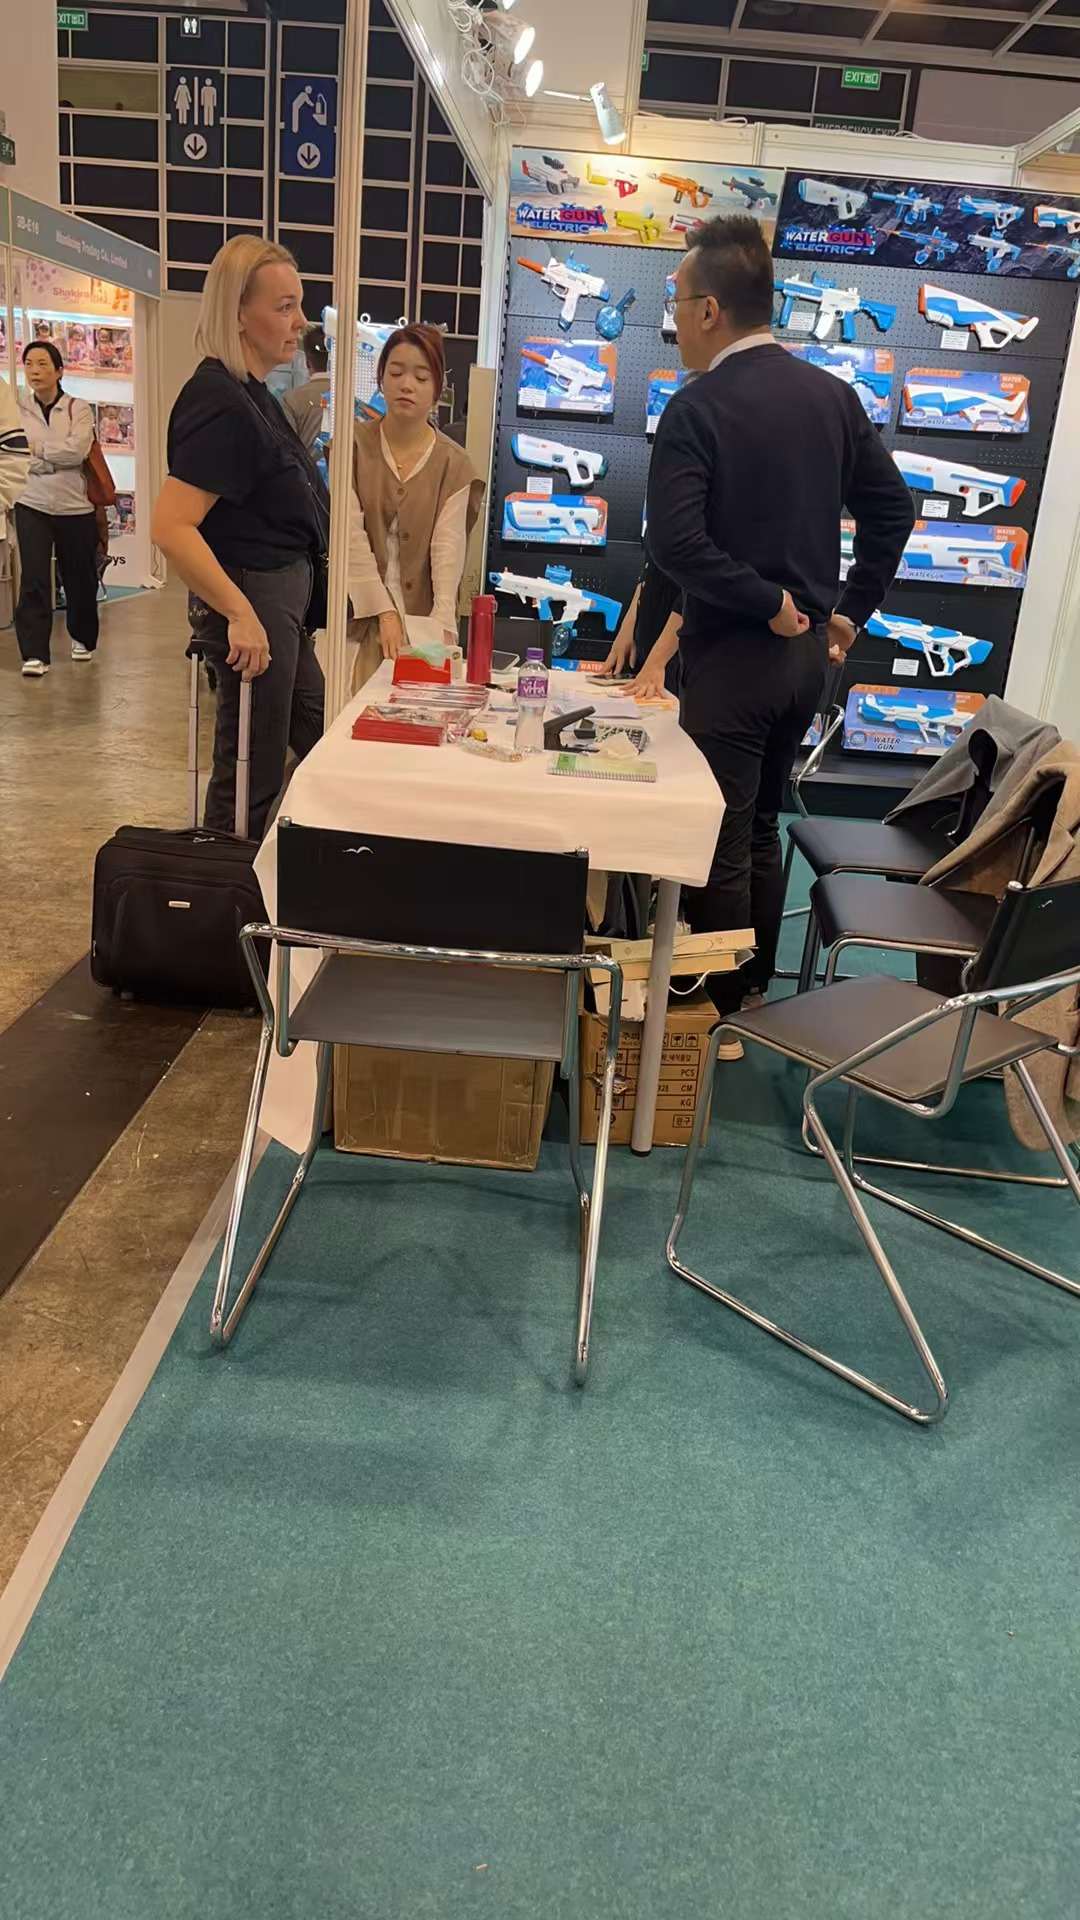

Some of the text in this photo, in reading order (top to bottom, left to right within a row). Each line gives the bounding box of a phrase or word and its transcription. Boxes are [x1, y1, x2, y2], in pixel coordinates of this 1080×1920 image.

[57, 13, 71, 24] XIT
[844, 71, 865, 83] EXIT
[518, 208, 560, 221] WATER
[528, 221, 590, 234] ELECTRIC
[786, 231, 828, 242] WATER
[795, 244, 855, 255] ELECTRIC
[873, 736, 902, 745] WATER
[877, 743, 895, 751] GUN
[681, 1069, 696, 1077] PCS
[680, 1083, 693, 1092] CM
